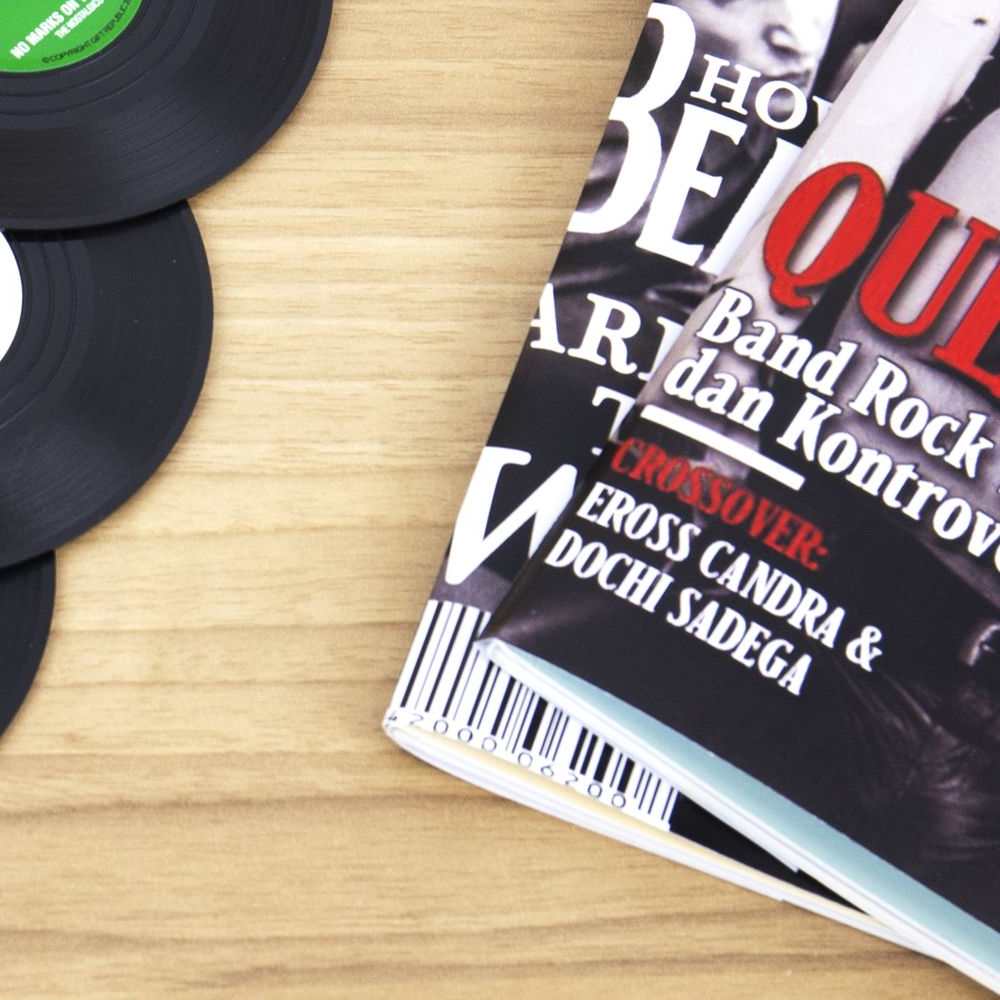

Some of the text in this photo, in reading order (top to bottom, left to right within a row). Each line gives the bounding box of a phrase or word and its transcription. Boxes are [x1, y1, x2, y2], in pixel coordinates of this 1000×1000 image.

[10, 41, 31, 60] NO
[25, 11, 65, 46] MARKS
[48, 42, 92, 63] COPYRIGHT
[54, 25, 71, 39] THE
[663, 346, 775, 432] dan
[697, 285, 995, 479] Band Rock
[610, 437, 828, 571] CROSSOVER:
[544, 528, 812, 696] DOCHI SADEGA
[576, 481, 883, 672] EROSS CANDRA &
